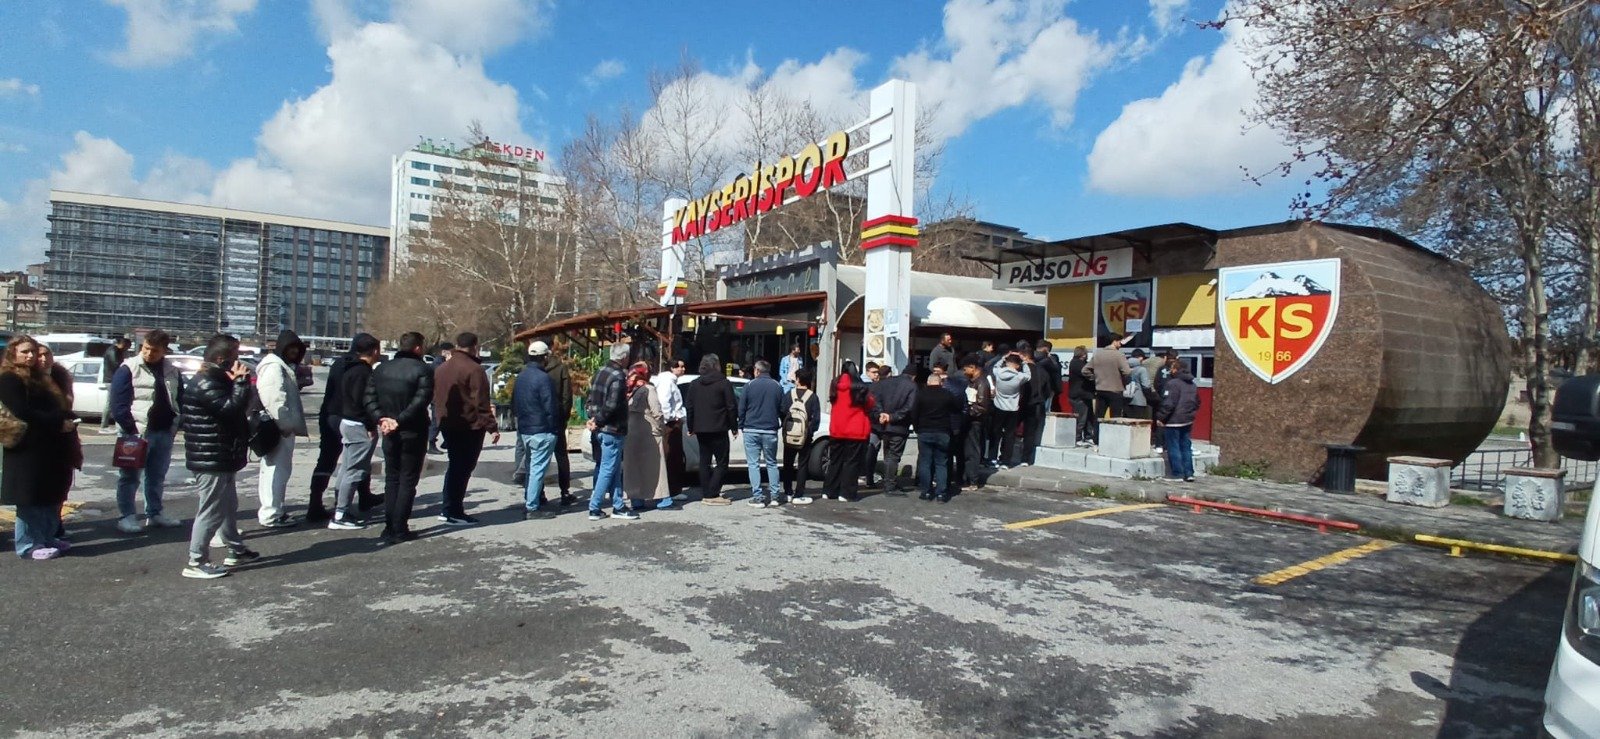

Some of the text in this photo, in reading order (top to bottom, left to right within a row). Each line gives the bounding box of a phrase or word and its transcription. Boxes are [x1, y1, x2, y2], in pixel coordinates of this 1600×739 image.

[484, 141, 544, 160] EKDEN
[672, 131, 850, 245] KAYSERİSPOR
[1239, 302, 1314, 340] KS
